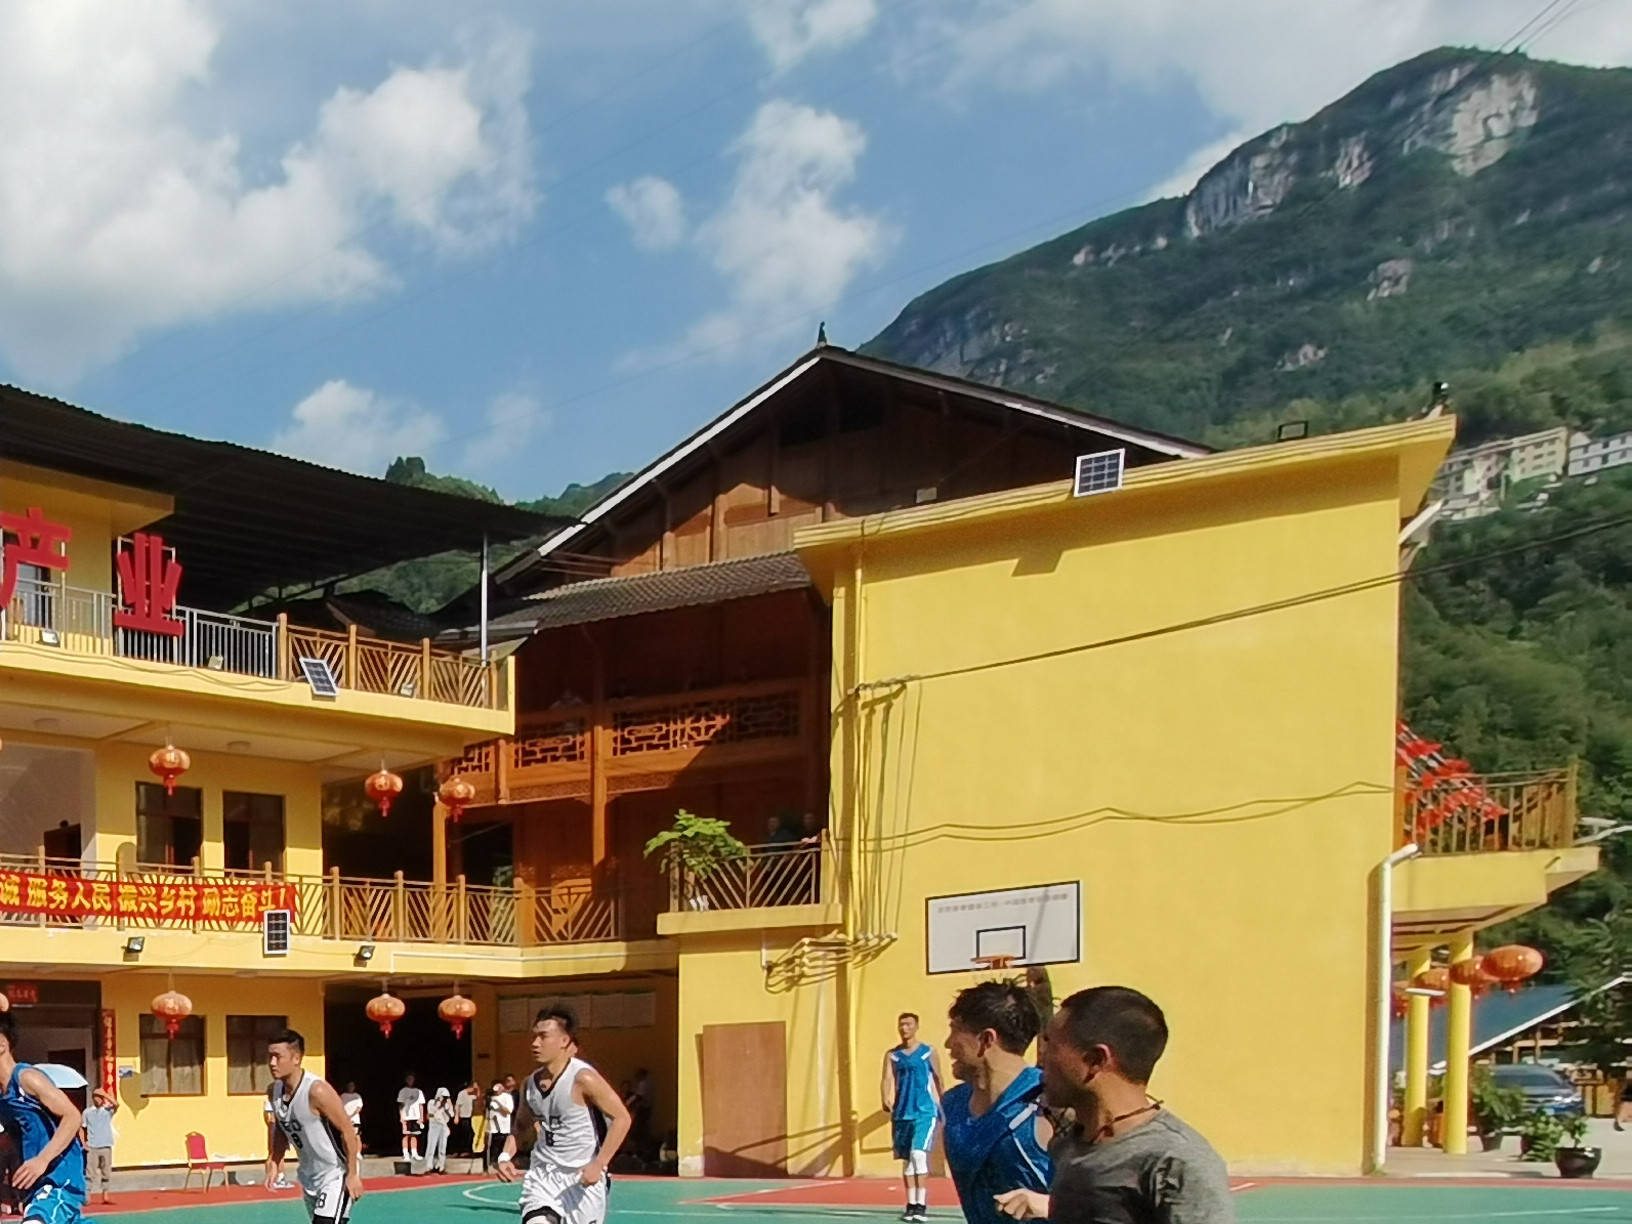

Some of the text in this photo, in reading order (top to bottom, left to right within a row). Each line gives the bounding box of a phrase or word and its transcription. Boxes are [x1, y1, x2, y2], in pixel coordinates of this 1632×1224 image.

[26, 876, 112, 911] 服务人民
[118, 884, 196, 916] 振兴乡村
